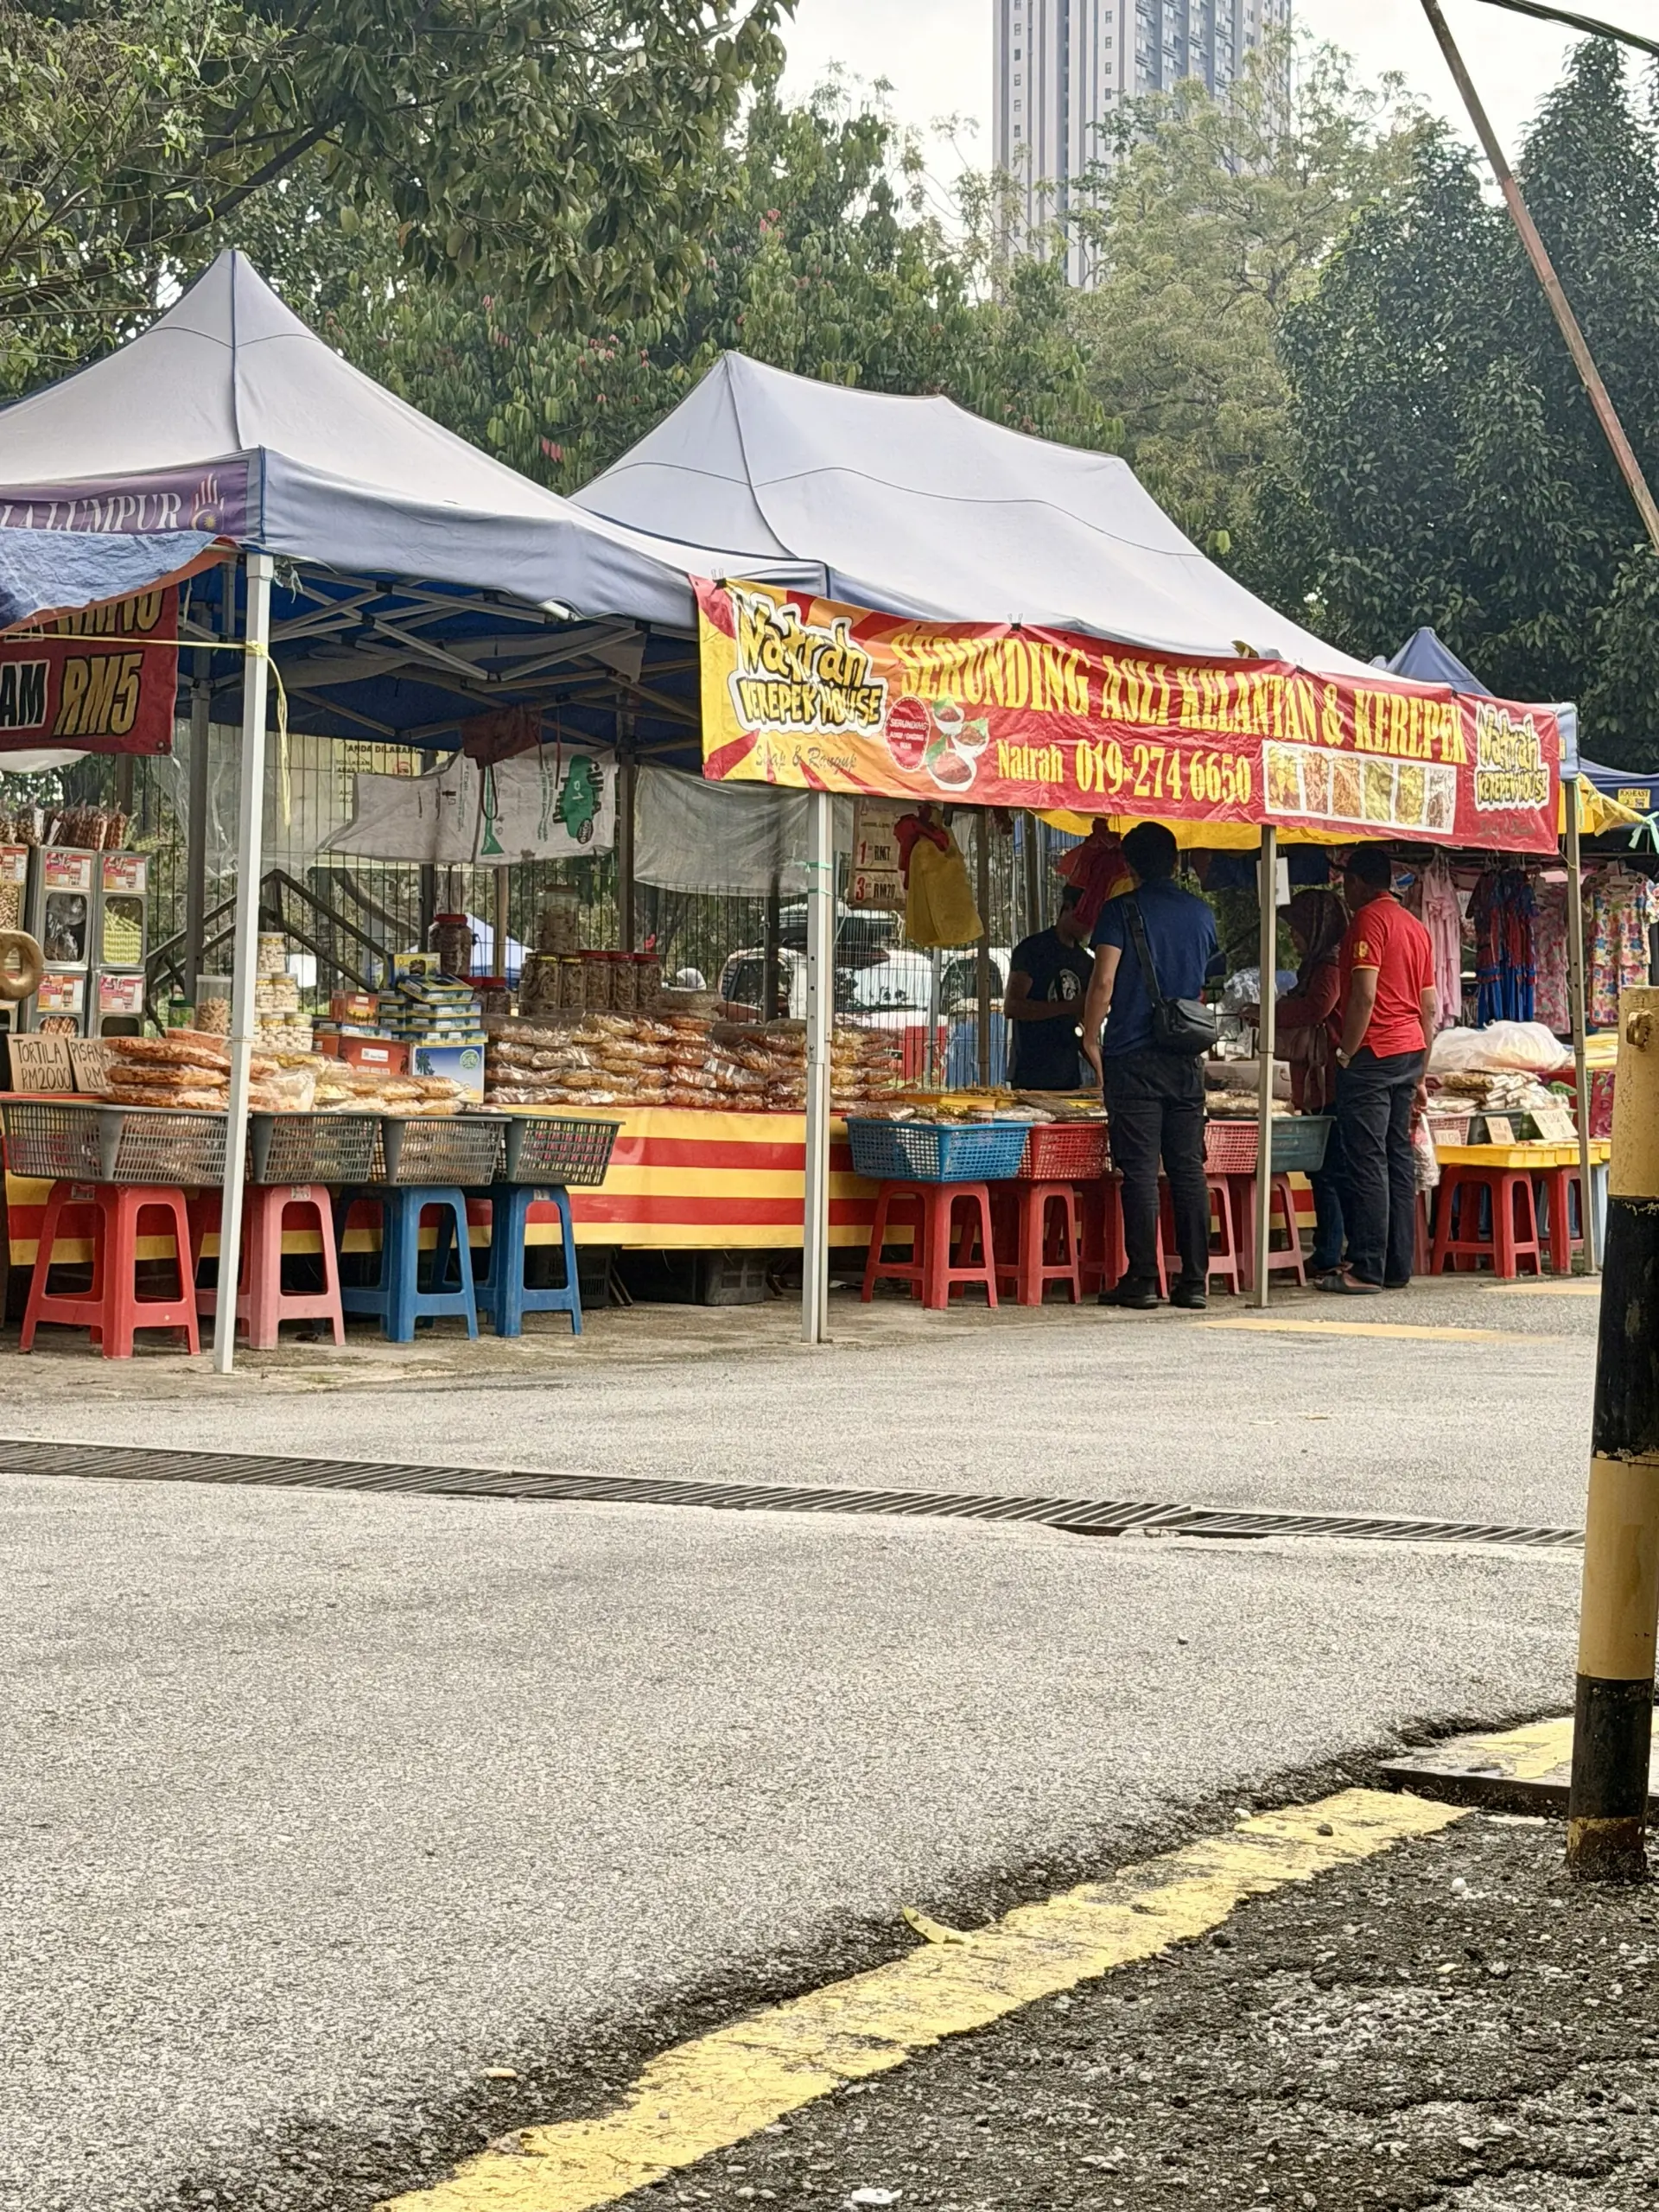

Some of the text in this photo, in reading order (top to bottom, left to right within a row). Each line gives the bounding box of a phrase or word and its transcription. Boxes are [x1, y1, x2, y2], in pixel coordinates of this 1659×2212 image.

[46, 493, 182, 532] LUMPUR
[737, 596, 868, 688] Natrah
[53, 652, 145, 737] RM5
[736, 678, 884, 728] KEREPEK HOUSE
[892, 632, 1469, 765] SERUNDING ASLI KELANTAN & KEREPEK
[996, 739, 1252, 804] Natrah 019-274 6650
[1478, 709, 1538, 772] Natrah
[13, 1039, 63, 1064] TORTILA
